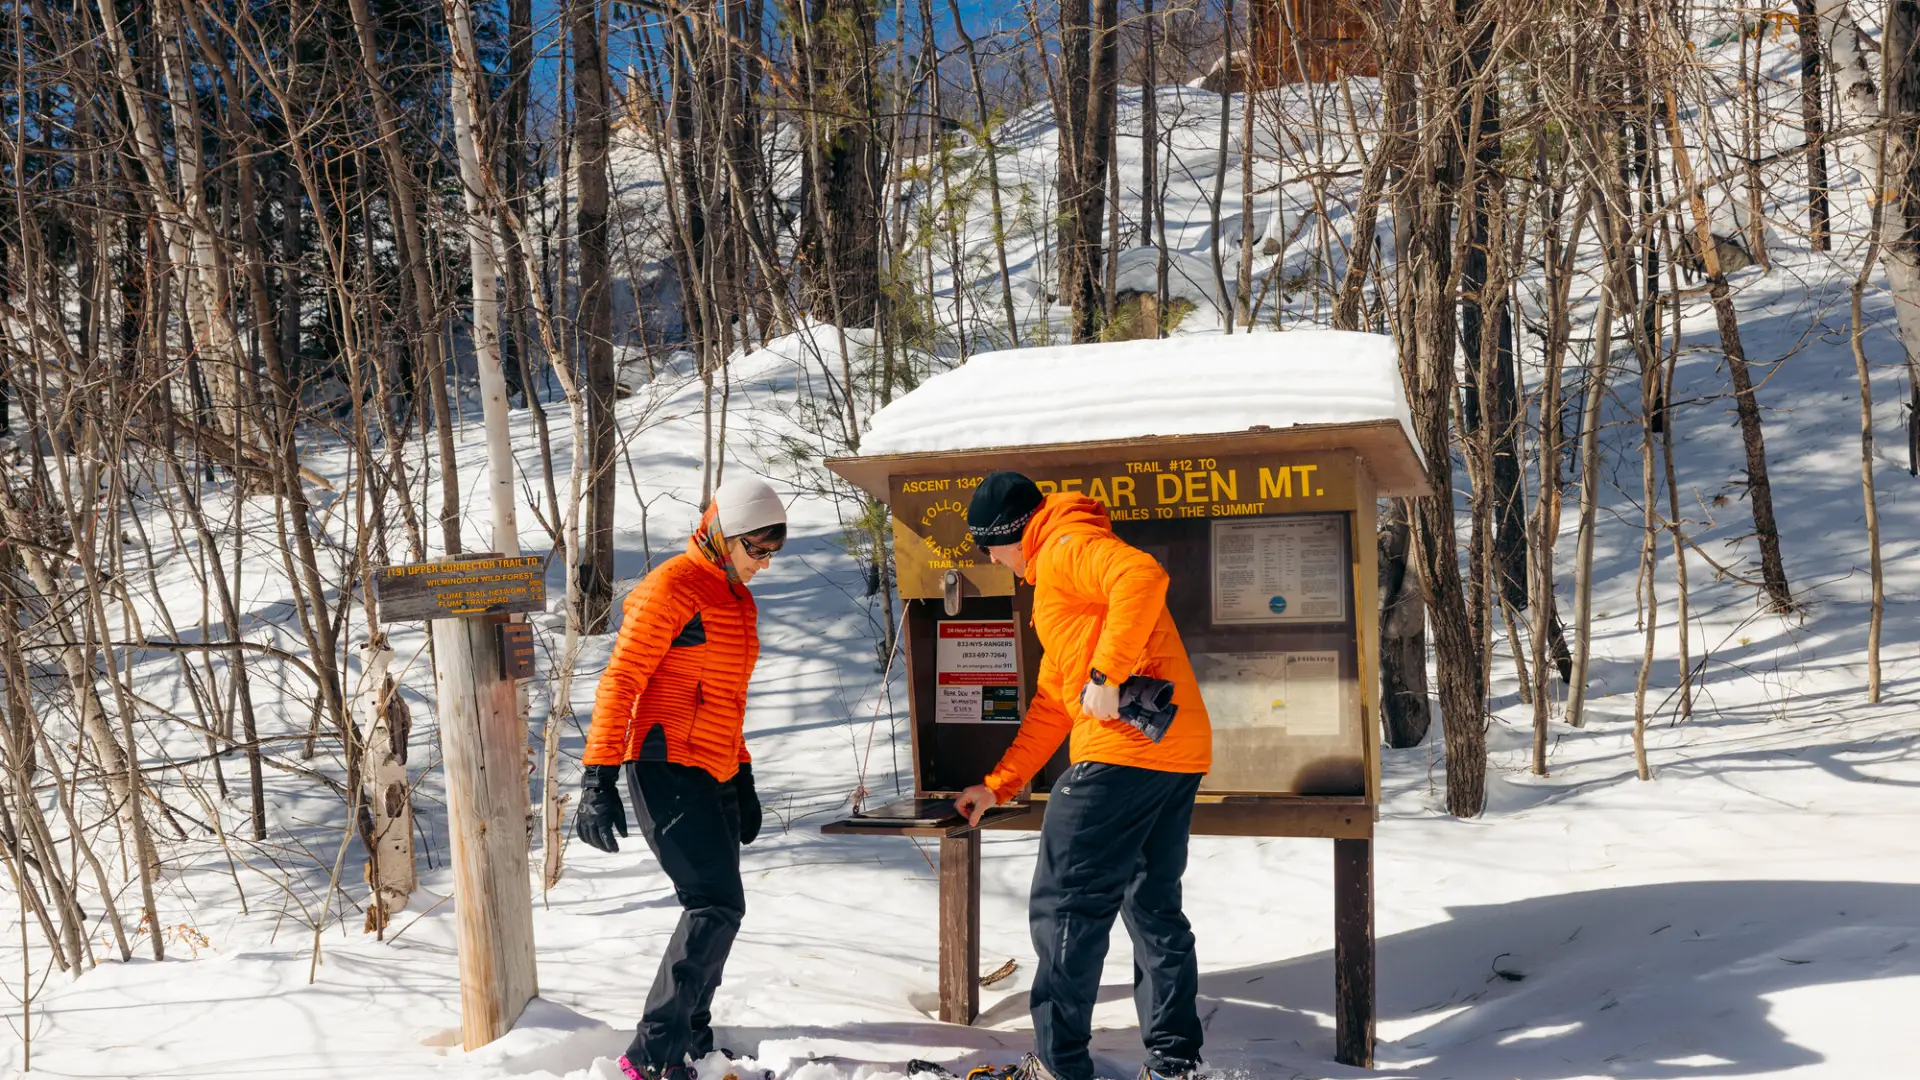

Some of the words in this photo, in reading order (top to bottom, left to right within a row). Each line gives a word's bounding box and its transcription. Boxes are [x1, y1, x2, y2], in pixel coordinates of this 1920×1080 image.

[1126, 461, 1163, 474] TRAIL
[1170, 459, 1193, 472] #12
[1198, 458, 1217, 470] TO
[902, 479, 950, 493] ASCENT
[1156, 470, 1238, 505] DEN
[1259, 465, 1324, 499] MT.
[1110, 508, 1149, 521] MILES
[1155, 507, 1174, 519] TO
[1179, 505, 1205, 518] THE
[1212, 502, 1265, 517] SUMMIT
[408, 565, 439, 576] UPPER
[440, 560, 495, 573] CONNECTOR
[498, 558, 524, 568] TRAIL
[526, 557, 538, 566] TO
[928, 559, 954, 569] TRAIL
[959, 559, 975, 568] #12
[426, 576, 479, 587] WILMINGTON
[481, 575, 501, 583] WILD
[502, 572, 534, 581] FOREST
[437, 592, 463, 600] FLUME
[465, 590, 486, 598] TRAIL
[488, 587, 527, 596] NETWORK
